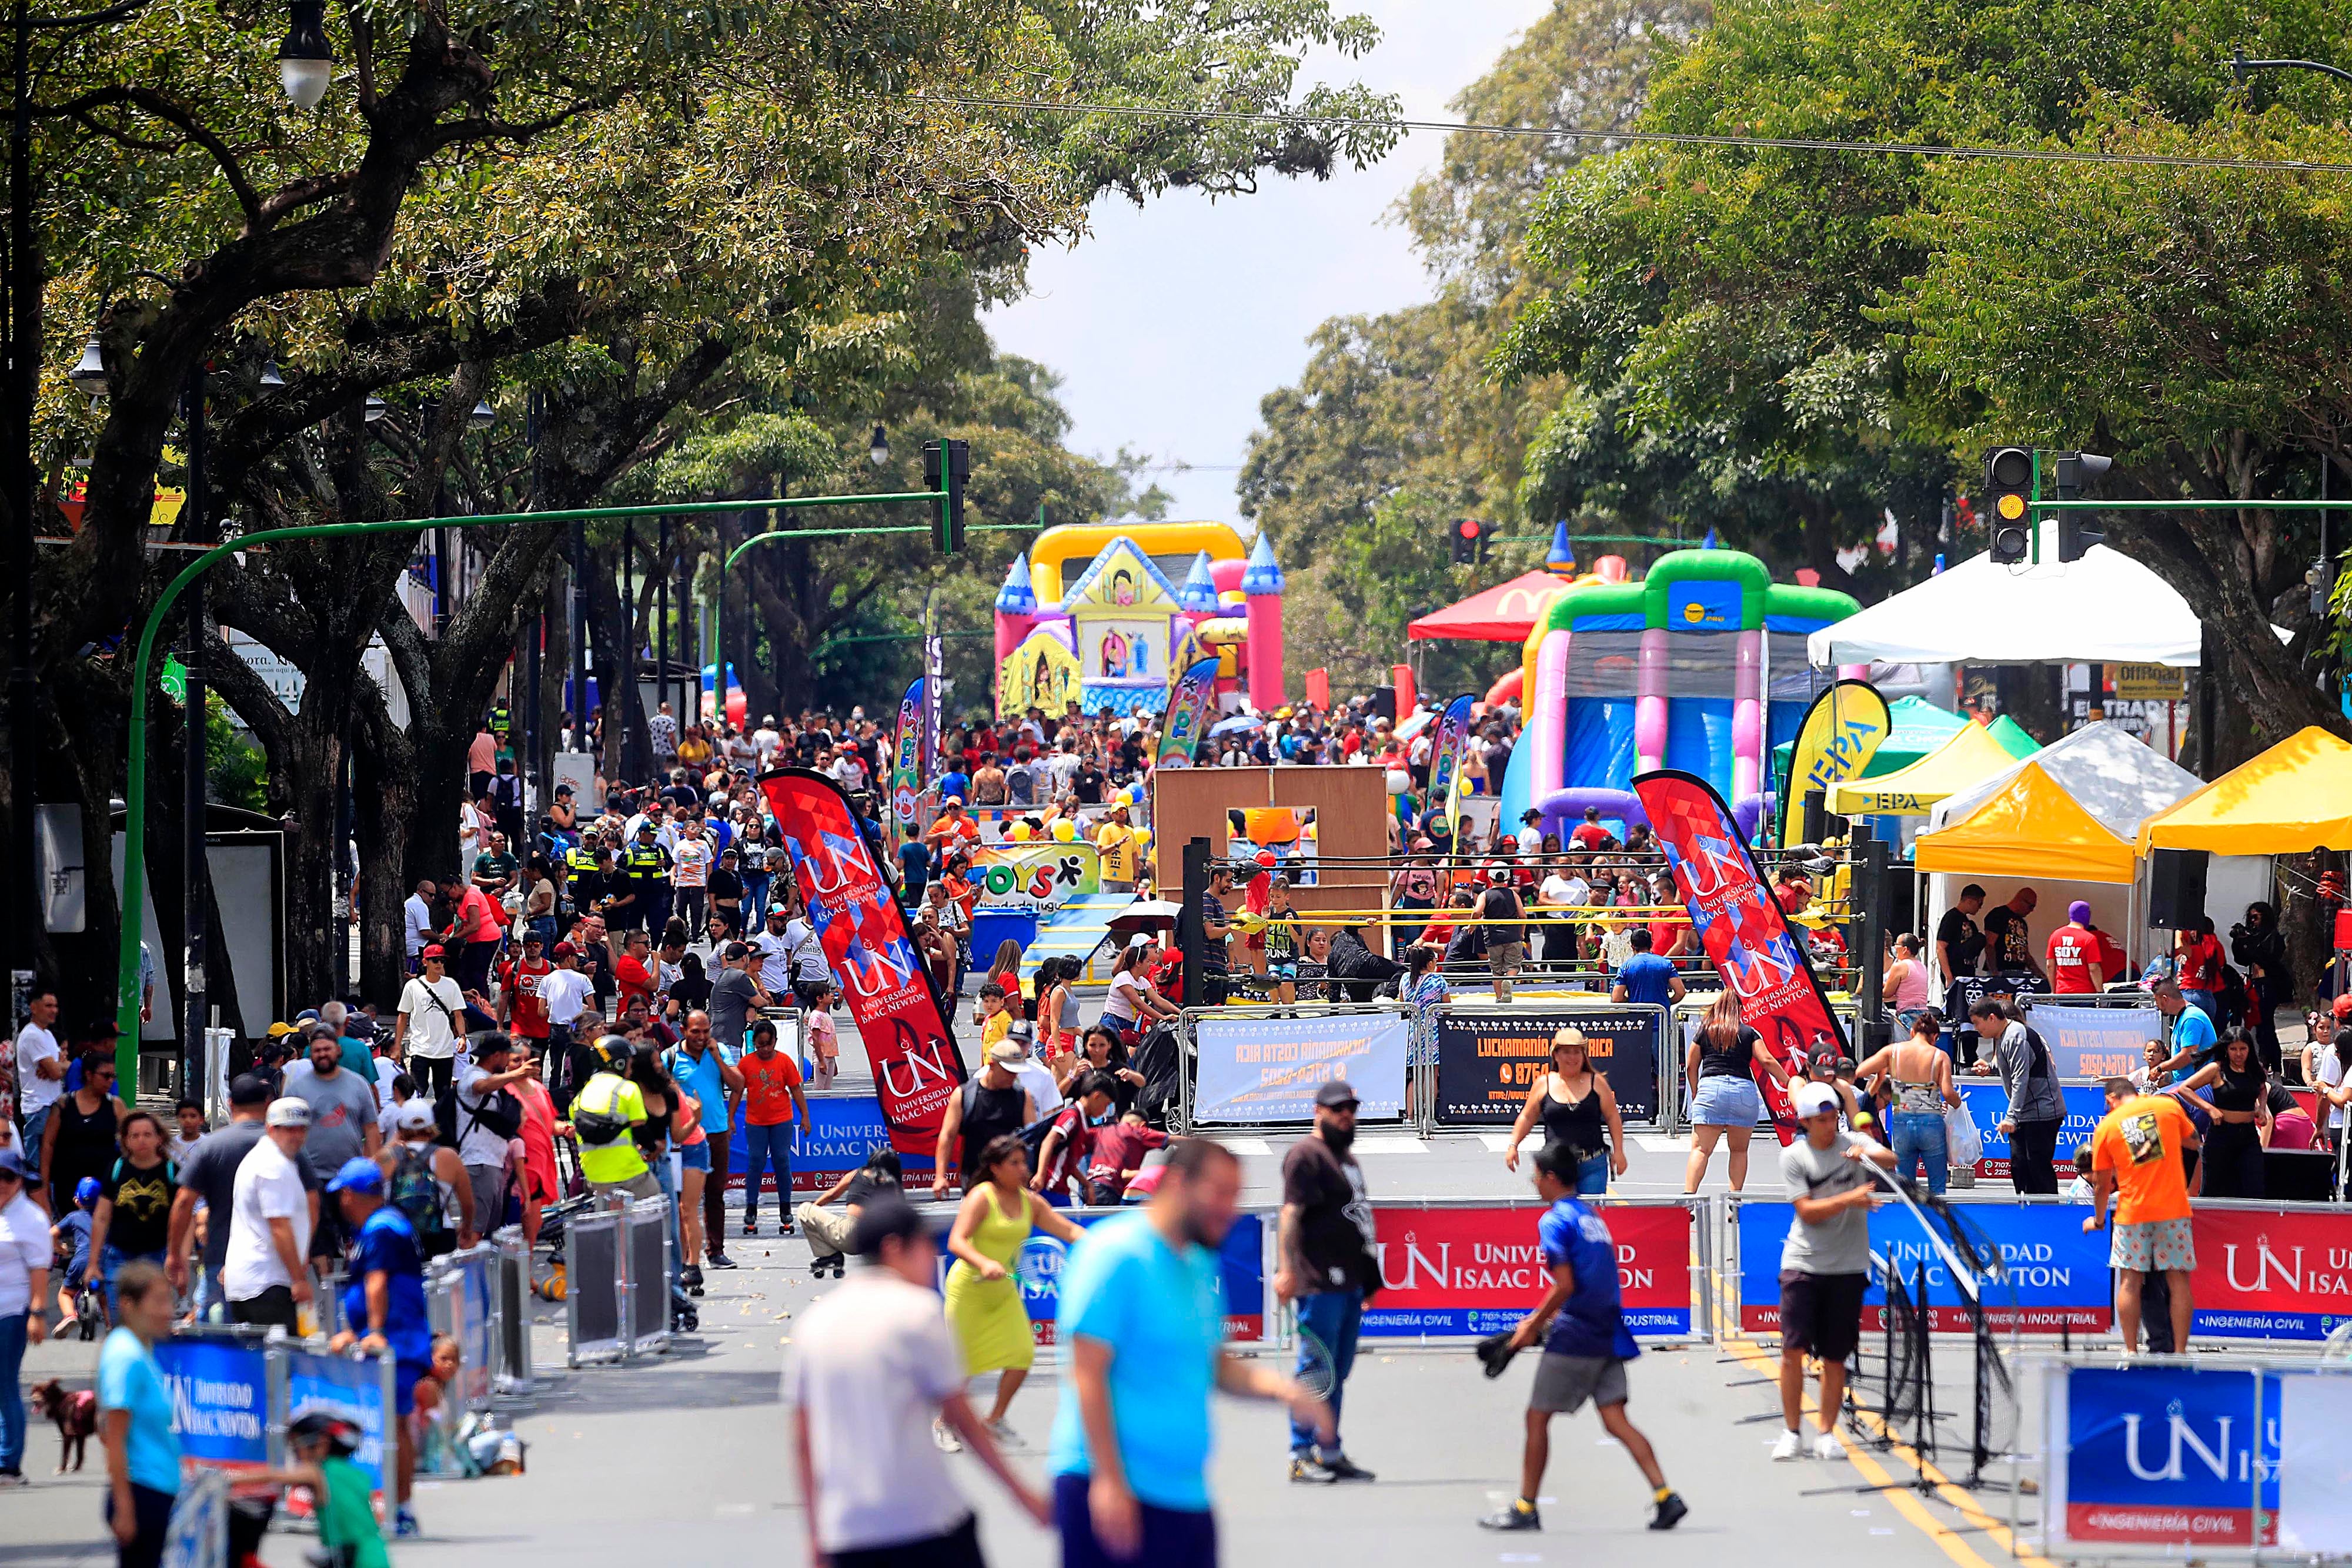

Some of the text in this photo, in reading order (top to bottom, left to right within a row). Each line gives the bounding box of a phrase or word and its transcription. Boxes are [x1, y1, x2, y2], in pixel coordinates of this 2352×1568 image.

[1171, 691, 1200, 738] TOYS
[1436, 734, 1458, 785] TOYS
[1876, 794, 1920, 810] EPA
[801, 836, 873, 893] UN
[1678, 837, 1746, 896] UN
[965, 863, 1056, 898] TOYS
[1698, 880, 1754, 911] UNIVERSIDAD
[817, 903, 846, 922] ISAAC
[1695, 905, 1726, 924] ISAAC
[2054, 947, 2082, 957] SOY
[2062, 936, 2074, 946] YO
[841, 939, 912, 997] UN
[1720, 936, 1795, 998] UN
[861, 985, 917, 1012] UNIVERSIDAD
[861, 992, 926, 1024] ISAAC NEWTON
[1741, 980, 1801, 1012] UNIVERSIDAD
[1769, 988, 1810, 1011] NEWTON
[1477, 1036, 1549, 1057] LUCHAMANÍA
[878, 1039, 948, 1098] UN
[896, 1085, 953, 1114] UNIVERSIDAD
[892, 1108, 922, 1125] ISAAC
[806, 1141, 861, 1156] ISAAC
[1374, 1242, 1451, 1290] UN
[1455, 1268, 1531, 1288] ISAAC
[2223, 1243, 2305, 1292] UN
[1424, 1315, 1453, 1326] CIVIL
[2027, 1314, 2097, 1325] INDUSTRIAL
[2205, 1315, 2305, 1330] INGENIERÍA CIVIL
[2122, 1413, 2231, 1481] UN
[2191, 1516, 2236, 1532] CIVIL
